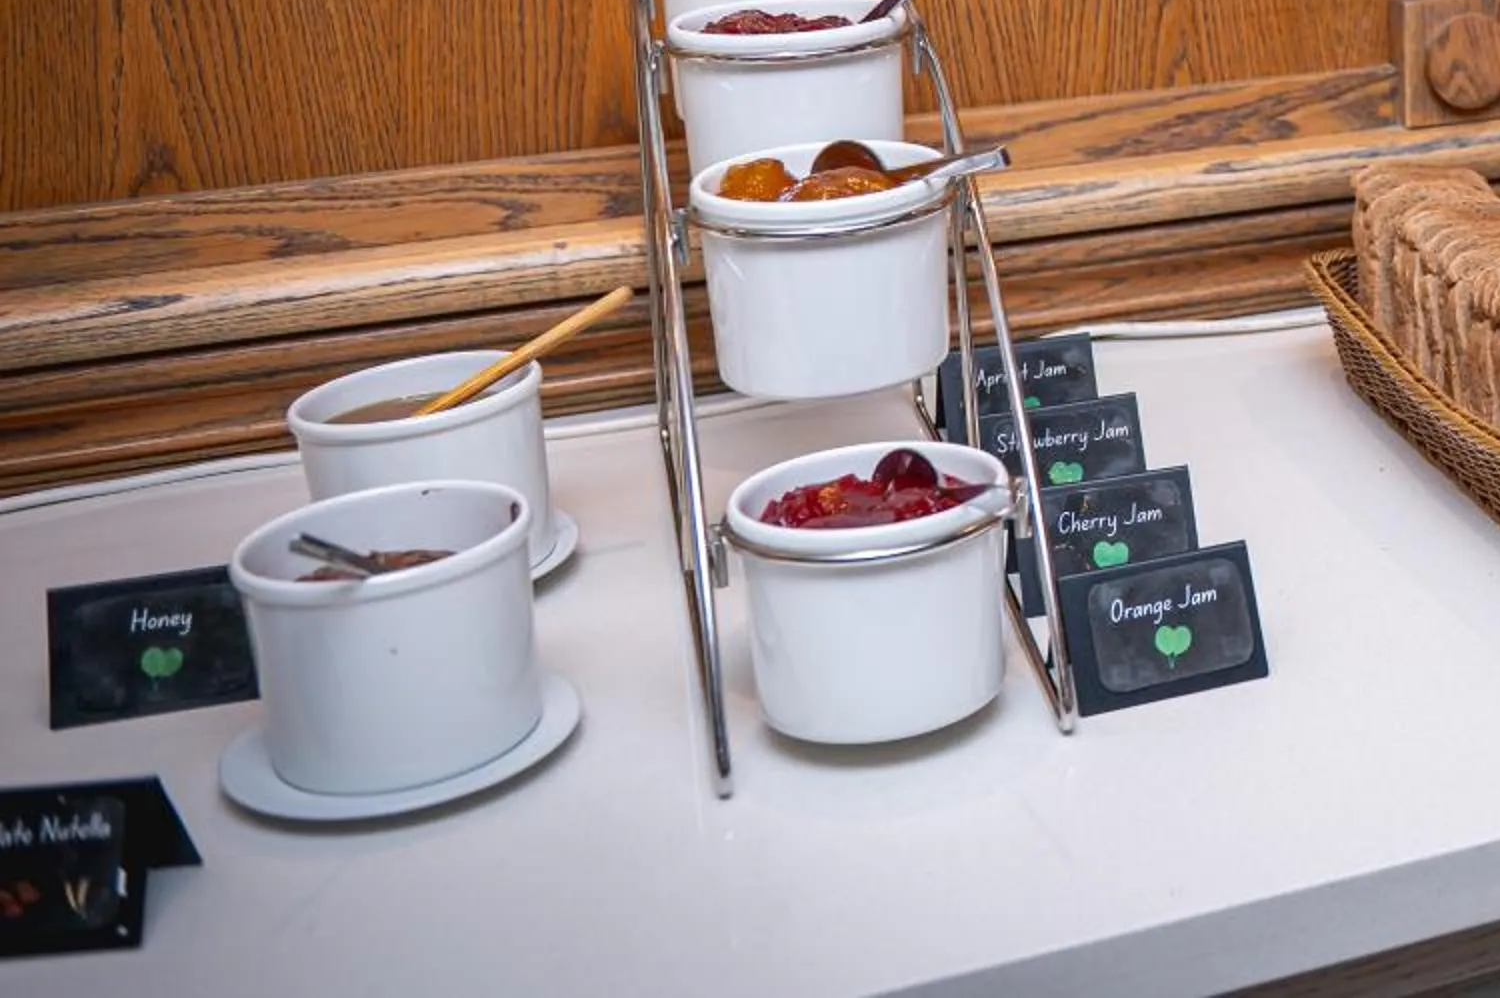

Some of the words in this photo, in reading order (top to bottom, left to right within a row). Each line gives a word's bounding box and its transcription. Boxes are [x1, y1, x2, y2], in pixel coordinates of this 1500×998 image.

[975, 362, 1029, 395] Aprt
[1034, 360, 1067, 381] Jam
[997, 427, 1088, 453] Stwberry
[1094, 420, 1129, 442] Jam
[1059, 510, 1117, 535] Cherry
[1123, 502, 1163, 526] Jam
[1110, 598, 1172, 625] Orange
[1178, 584, 1217, 609] Jam
[130, 609, 193, 636] Honey
